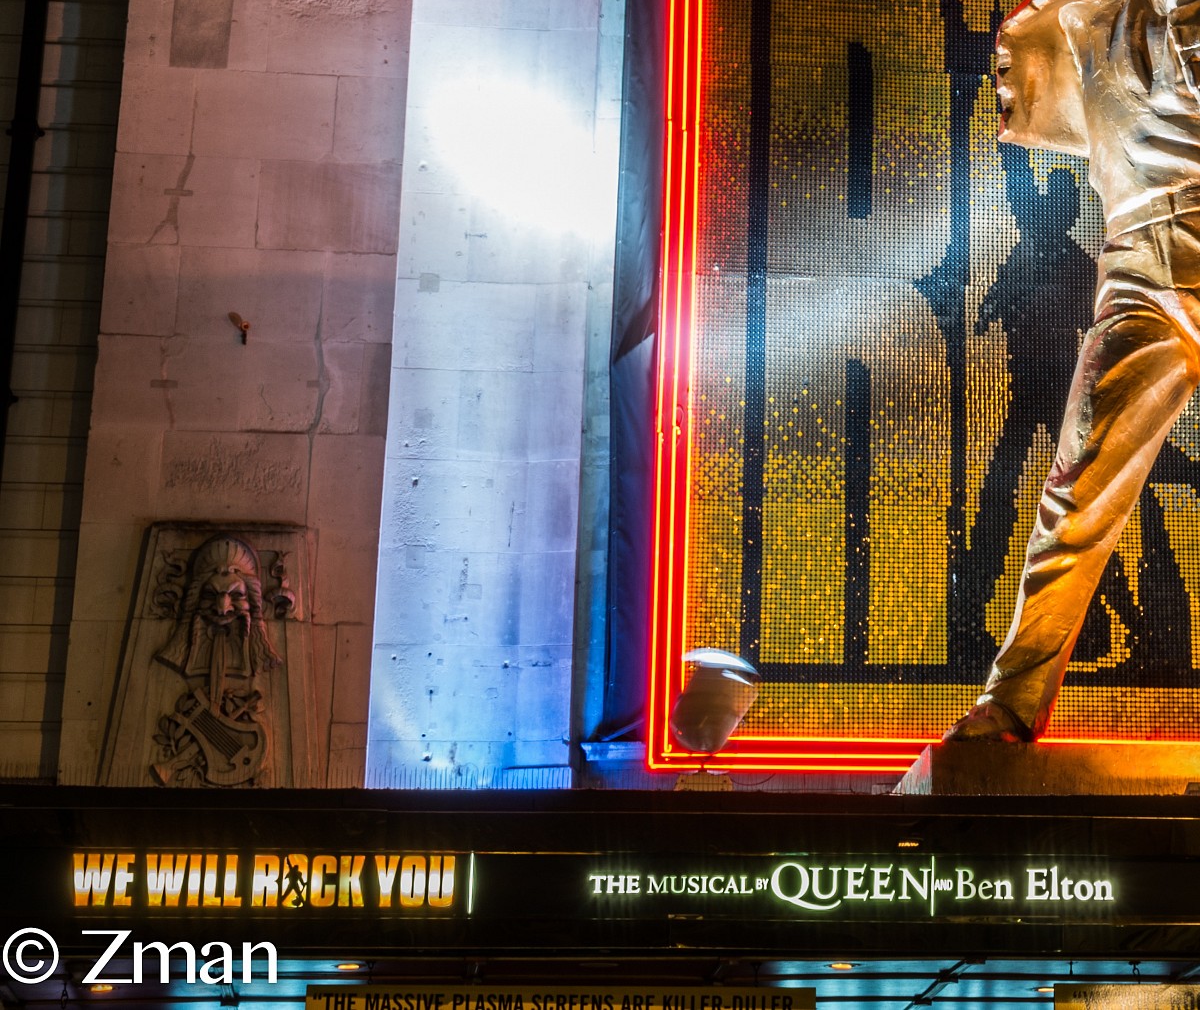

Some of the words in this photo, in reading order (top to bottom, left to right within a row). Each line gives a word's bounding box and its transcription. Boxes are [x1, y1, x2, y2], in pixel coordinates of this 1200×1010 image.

[73, 853, 136, 907] WE
[146, 854, 242, 908] WILL
[251, 854, 366, 908] ROCK
[374, 855, 456, 908] YOU
[589, 874, 641, 894] THE
[646, 875, 753, 894] MUSICAL
[755, 878, 769, 891] BY
[770, 862, 932, 911] QUEEN
[933, 878, 954, 892] AND
[955, 867, 1014, 900] Ben
[1025, 865, 1114, 901] Elton
[365, 993, 445, 1010] MASSIVE
[453, 994, 524, 1010] PLASMA
[531, 994, 614, 1010] SCREENS
[622, 995, 656, 1010] ARE
